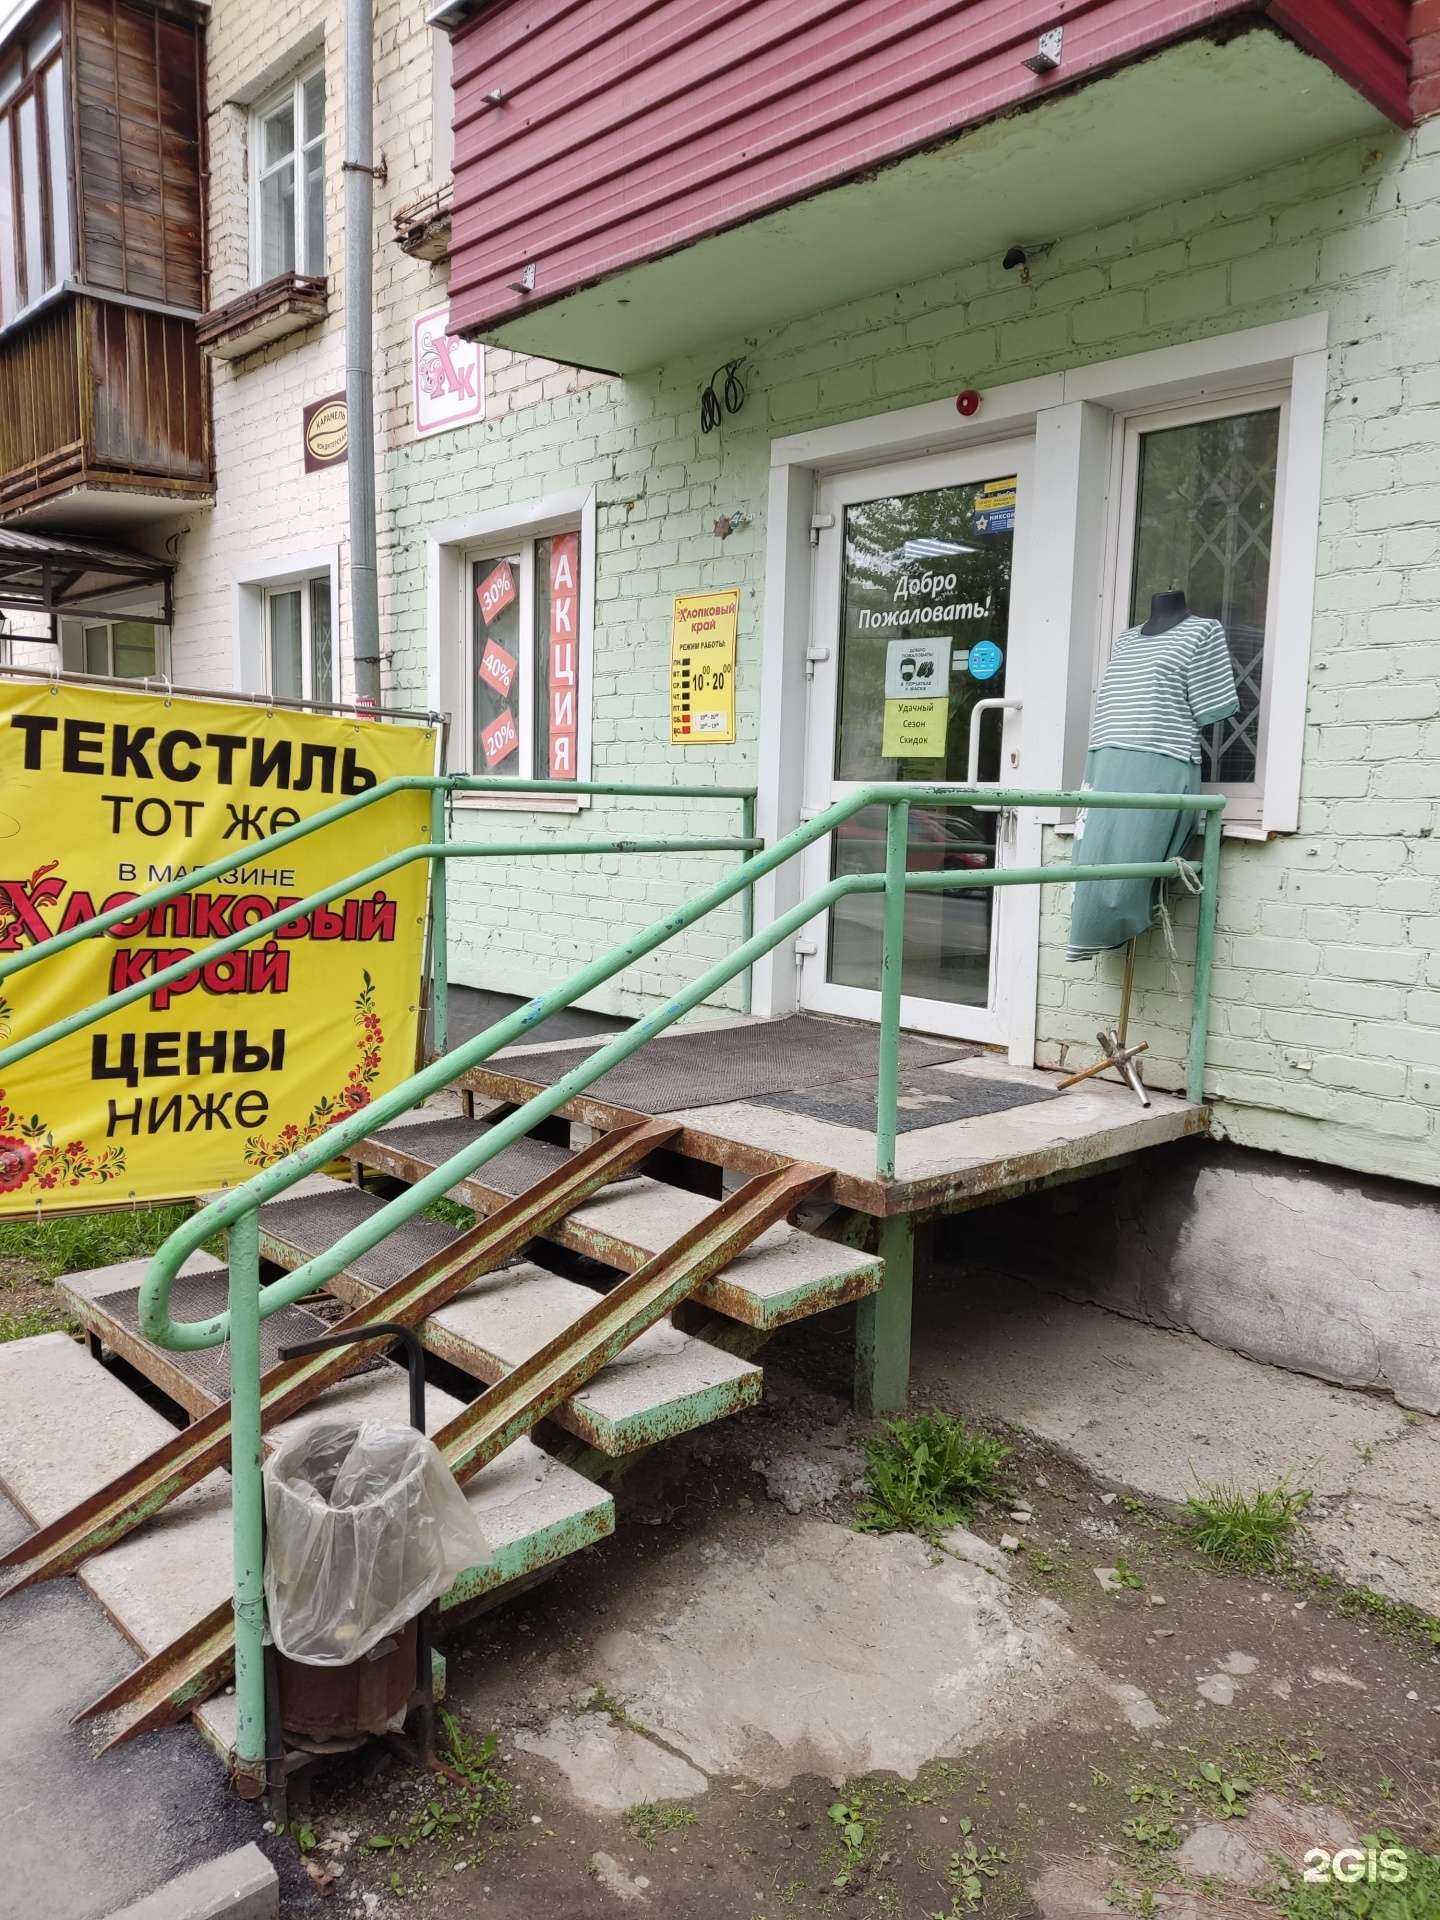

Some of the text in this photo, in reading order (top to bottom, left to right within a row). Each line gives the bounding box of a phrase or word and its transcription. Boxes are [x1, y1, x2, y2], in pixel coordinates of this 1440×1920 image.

[893, 570, 957, 602] Добро
[677, 602, 736, 622] Хлопковый
[858, 595, 992, 629] Пожаловать!
[691, 618, 716, 635] край
[680, 642, 700, 651] РЕЖИМ
[553, 553, 575, 771] АКЦИЯ
[898, 702, 934, 713] Удачный
[903, 719, 926, 728] Сезон
[899, 735, 928, 746] Скидок
[10, 714, 378, 796] ТЕКСТИЛЬ
[90, 1029, 286, 1088] ЦЕНЫ
[106, 1089, 270, 1138] ниже
